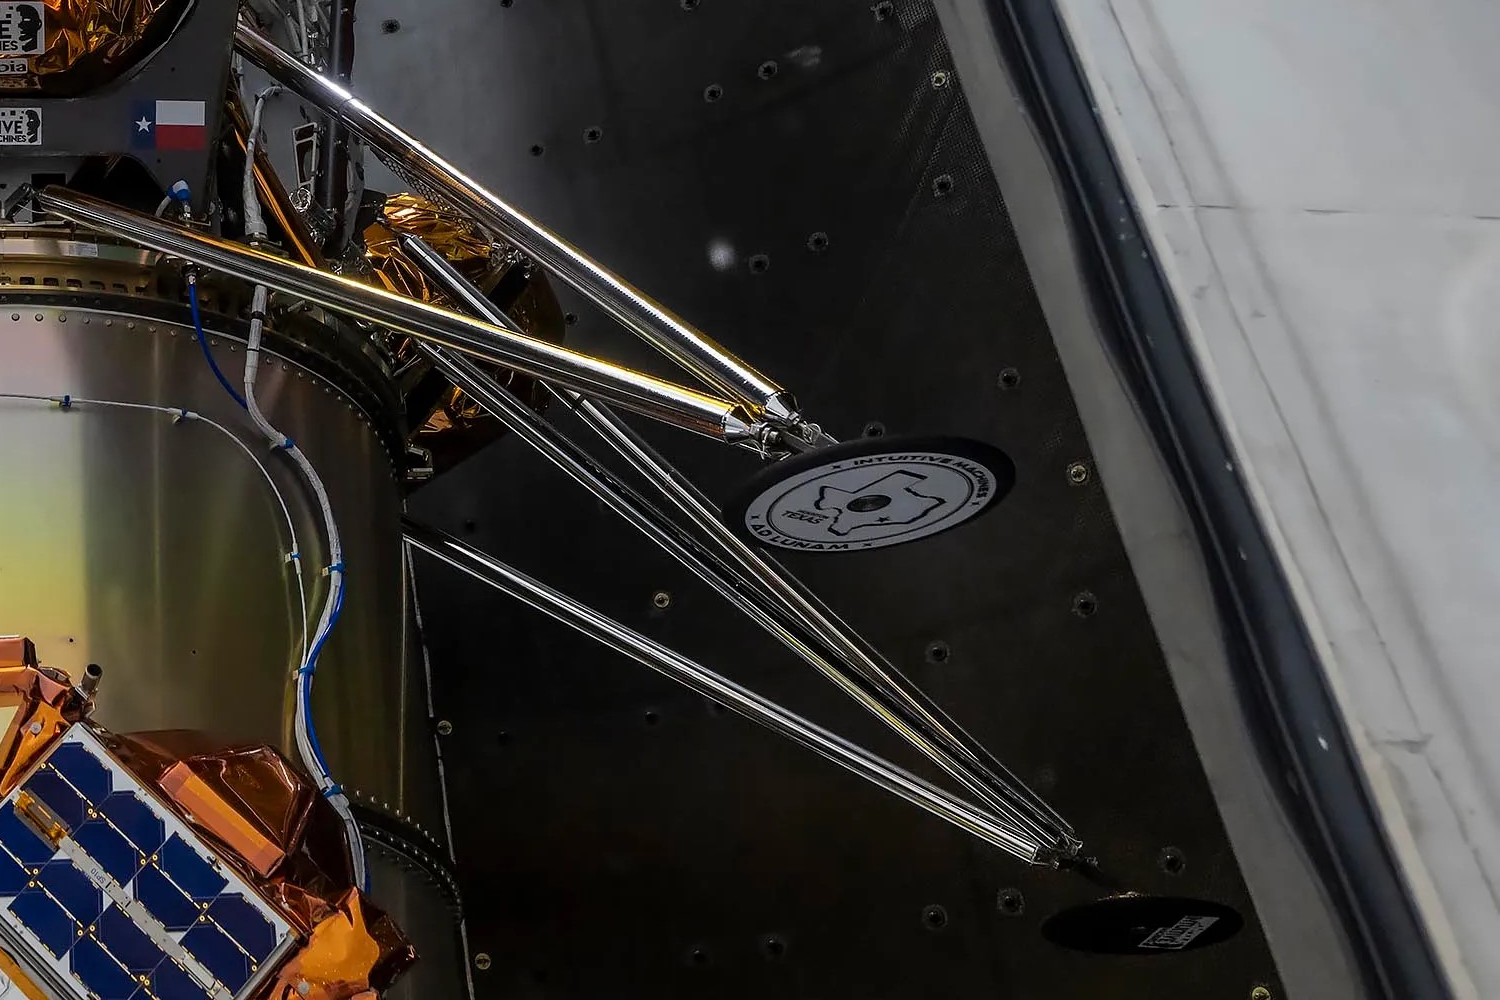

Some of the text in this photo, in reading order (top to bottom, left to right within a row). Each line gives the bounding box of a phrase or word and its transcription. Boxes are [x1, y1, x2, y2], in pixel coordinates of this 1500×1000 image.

[853, 455, 989, 498] INTUITIVE MACHINES
[781, 510, 825, 524] TEXAS
[750, 524, 849, 550] AD LUNAM
